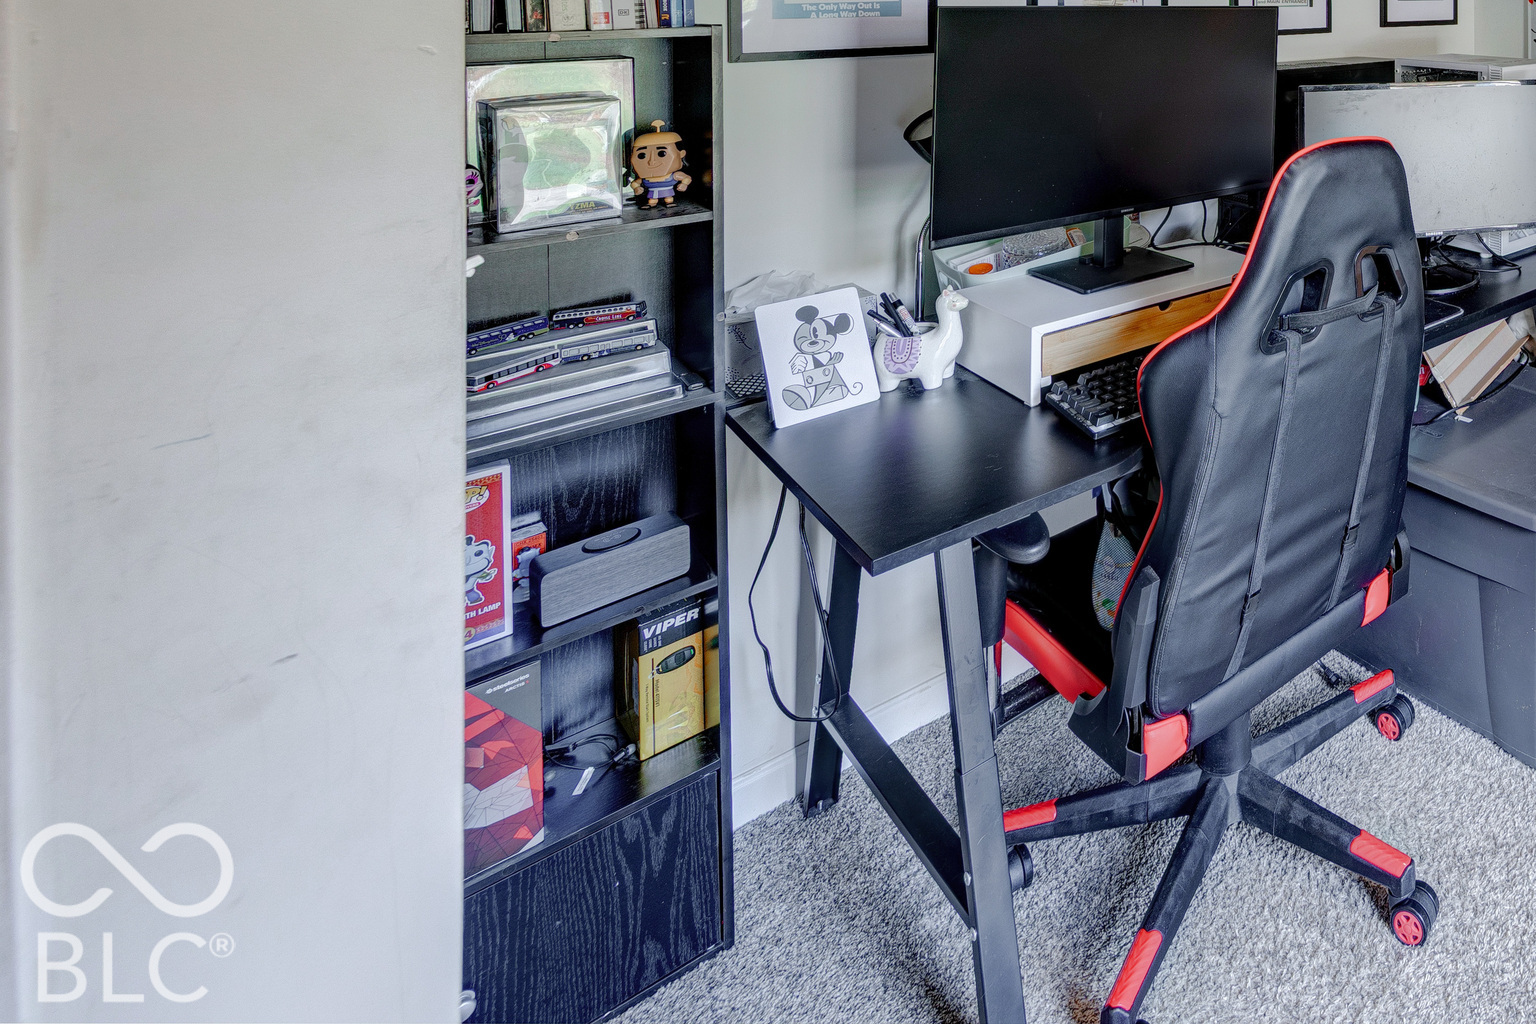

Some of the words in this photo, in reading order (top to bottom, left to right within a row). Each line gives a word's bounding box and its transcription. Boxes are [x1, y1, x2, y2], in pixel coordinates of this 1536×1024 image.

[818, 3, 838, 12] Only
[839, 3, 856, 11] Way
[478, 601, 501, 616] LAMP
[643, 607, 700, 640] VIPER
[493, 674, 530, 692] steelseries
